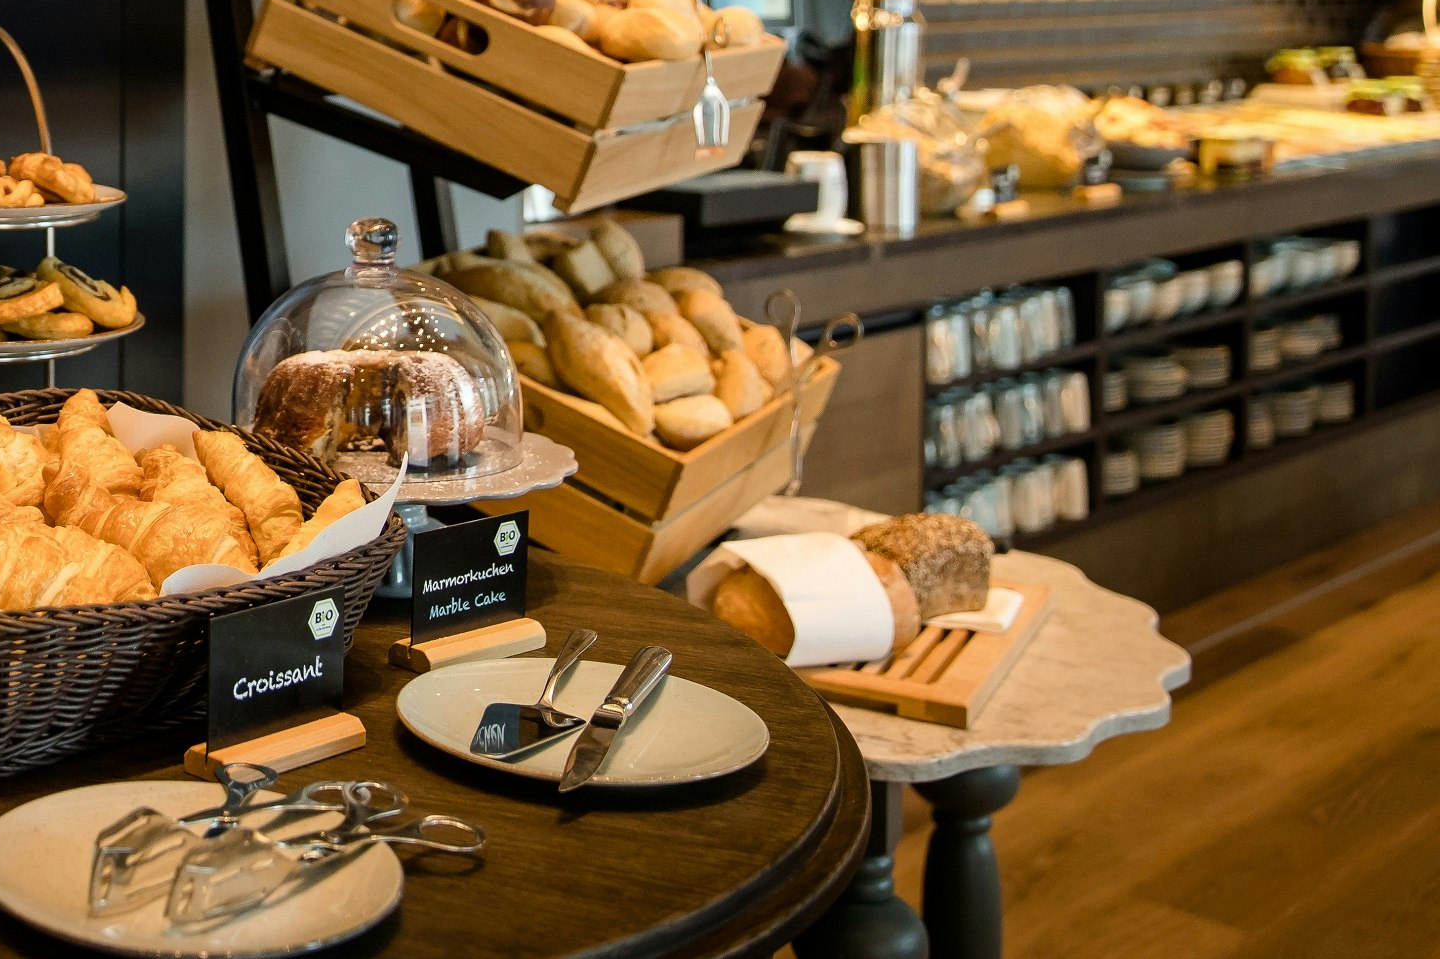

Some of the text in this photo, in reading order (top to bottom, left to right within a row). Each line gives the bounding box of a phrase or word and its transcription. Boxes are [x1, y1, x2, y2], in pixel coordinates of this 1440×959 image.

[422, 562, 515, 595] Marmorkuchen
[429, 591, 507, 620] Marble Cake
[233, 655, 323, 700] Croissant
